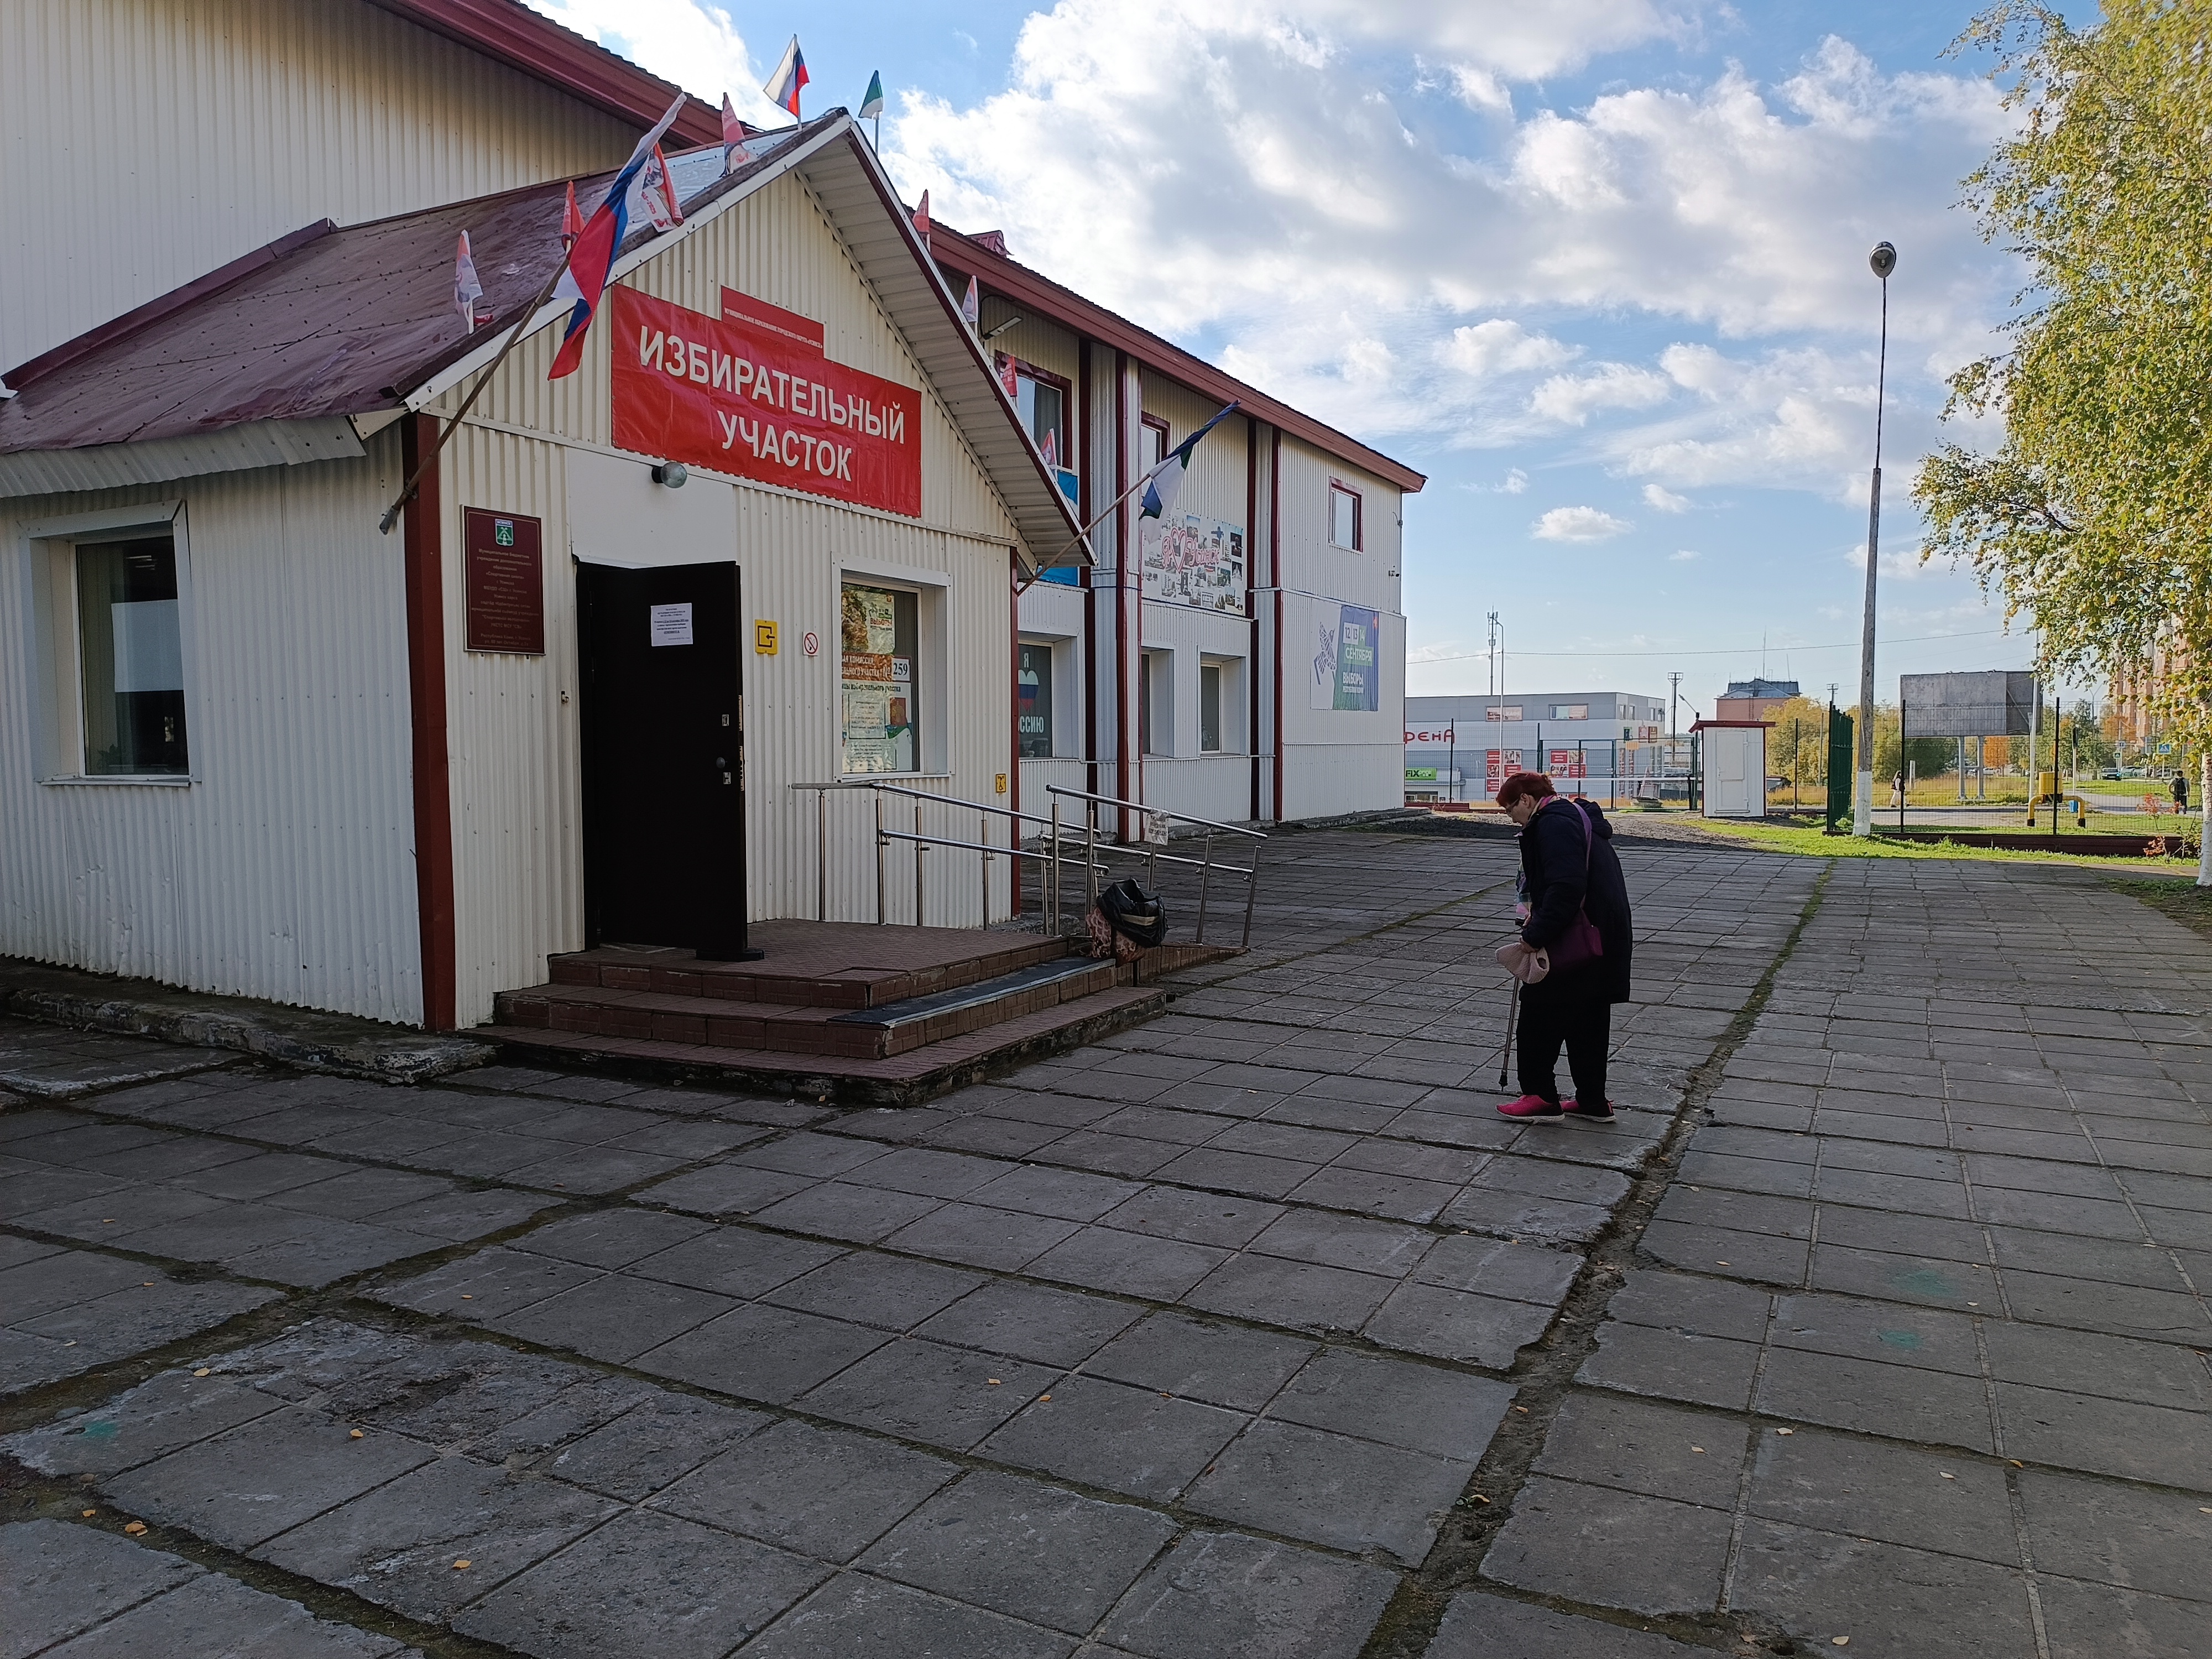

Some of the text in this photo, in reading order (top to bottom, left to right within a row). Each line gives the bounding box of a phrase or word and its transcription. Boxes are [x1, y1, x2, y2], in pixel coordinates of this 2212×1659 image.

[640, 325, 905, 444] ИЗБИРАТЕЛЬНЫЙ
[717, 410, 852, 482] УЧАСТОК
[1345, 627, 1350, 639] 12
[1353, 628, 1358, 640] 13
[1024, 653, 1029, 668] Я
[1345, 646, 1372, 662] СЕНТЯБРЯ
[893, 663, 907, 675] 259
[1343, 671, 1364, 685] ВЫБОРЫ
[1018, 716, 1044, 733] ССИЮ
